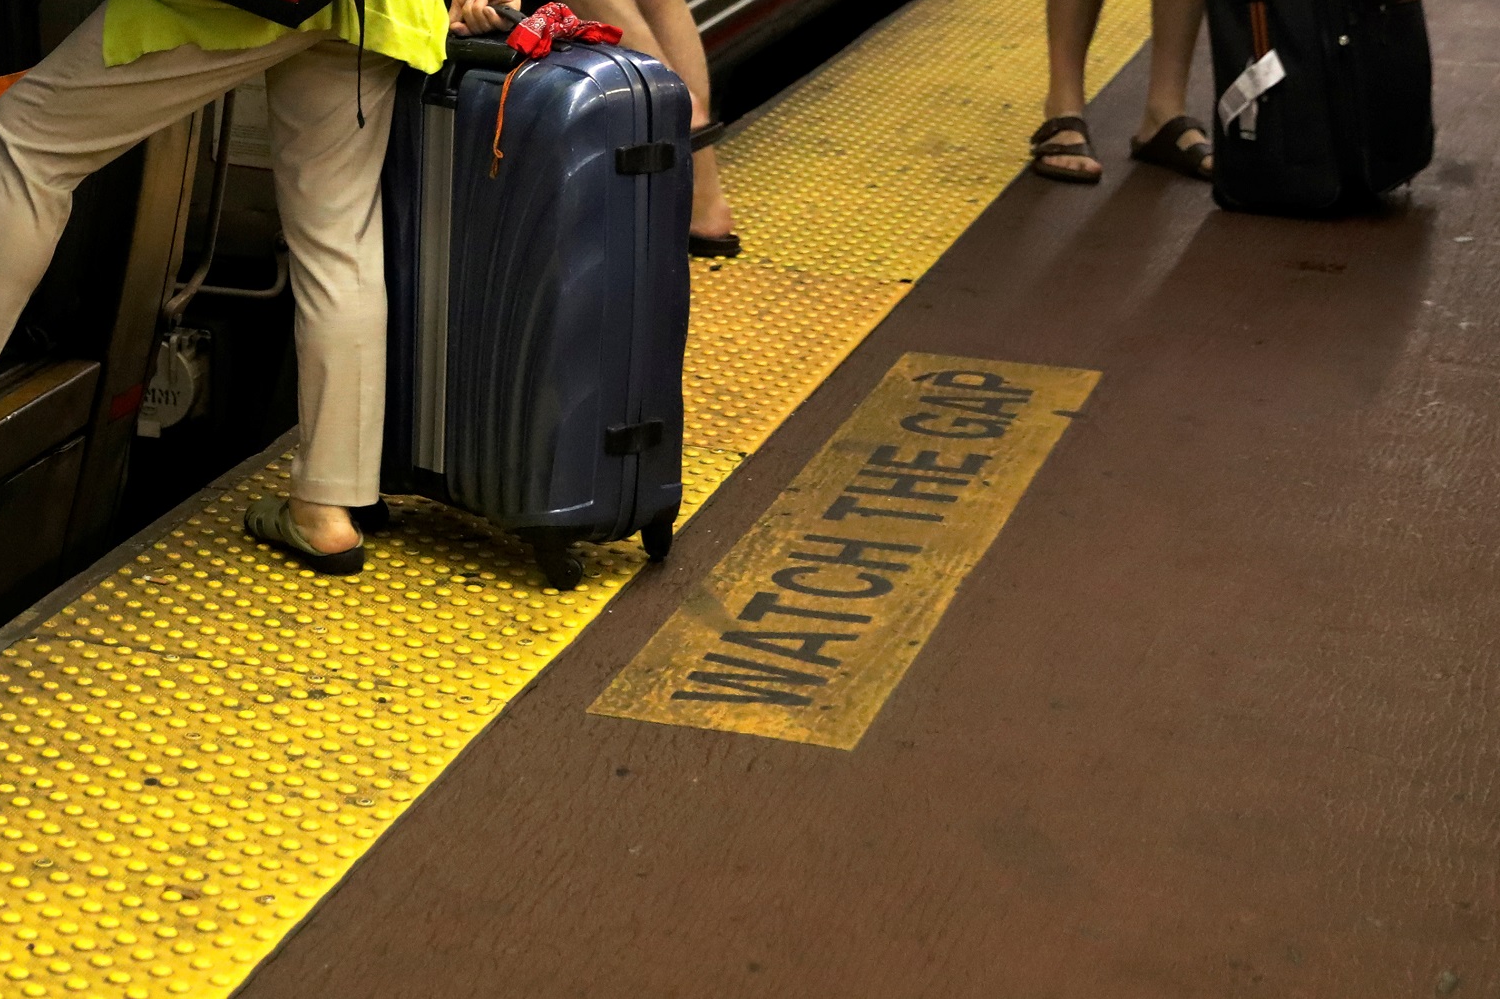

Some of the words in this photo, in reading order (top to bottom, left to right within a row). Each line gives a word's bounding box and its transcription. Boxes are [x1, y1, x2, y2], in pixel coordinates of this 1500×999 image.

[900, 370, 1035, 439] GAP
[822, 444, 993, 523] THE
[672, 534, 924, 707] WATCH
